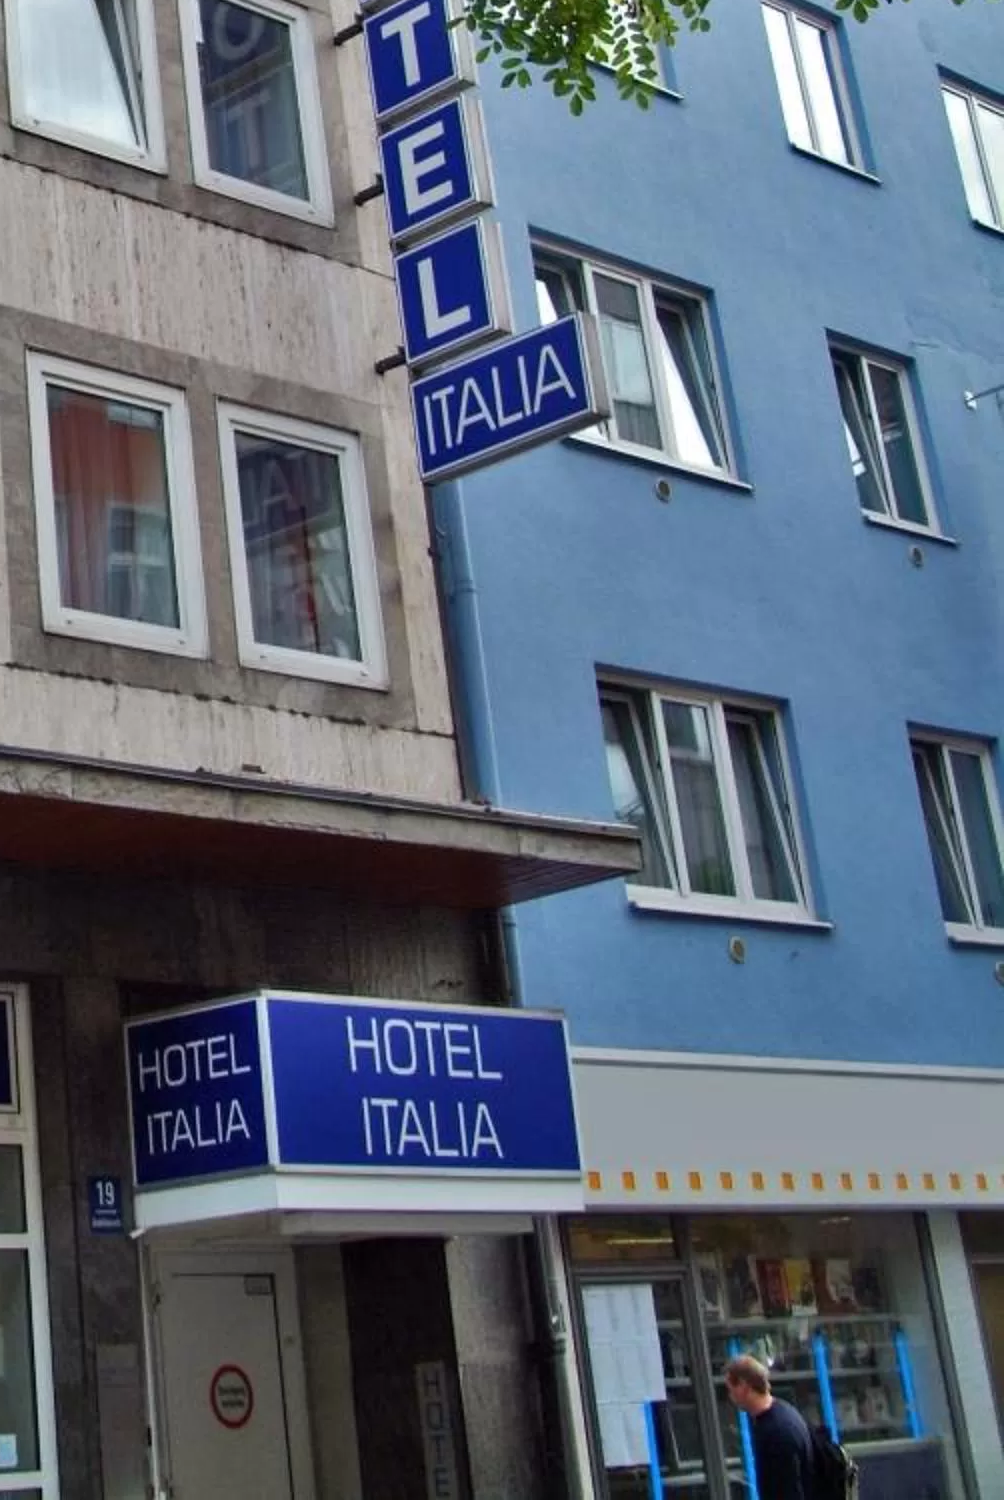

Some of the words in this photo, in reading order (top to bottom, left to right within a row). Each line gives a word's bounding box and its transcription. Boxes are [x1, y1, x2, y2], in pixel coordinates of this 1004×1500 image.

[422, 343, 576, 456] ITALIA
[138, 1032, 251, 1092] HOTEL
[345, 1015, 503, 1080] HOTEL
[147, 1098, 251, 1156] ITALIA
[361, 1096, 504, 1159] ITALIA
[96, 1180, 116, 1206] 19
